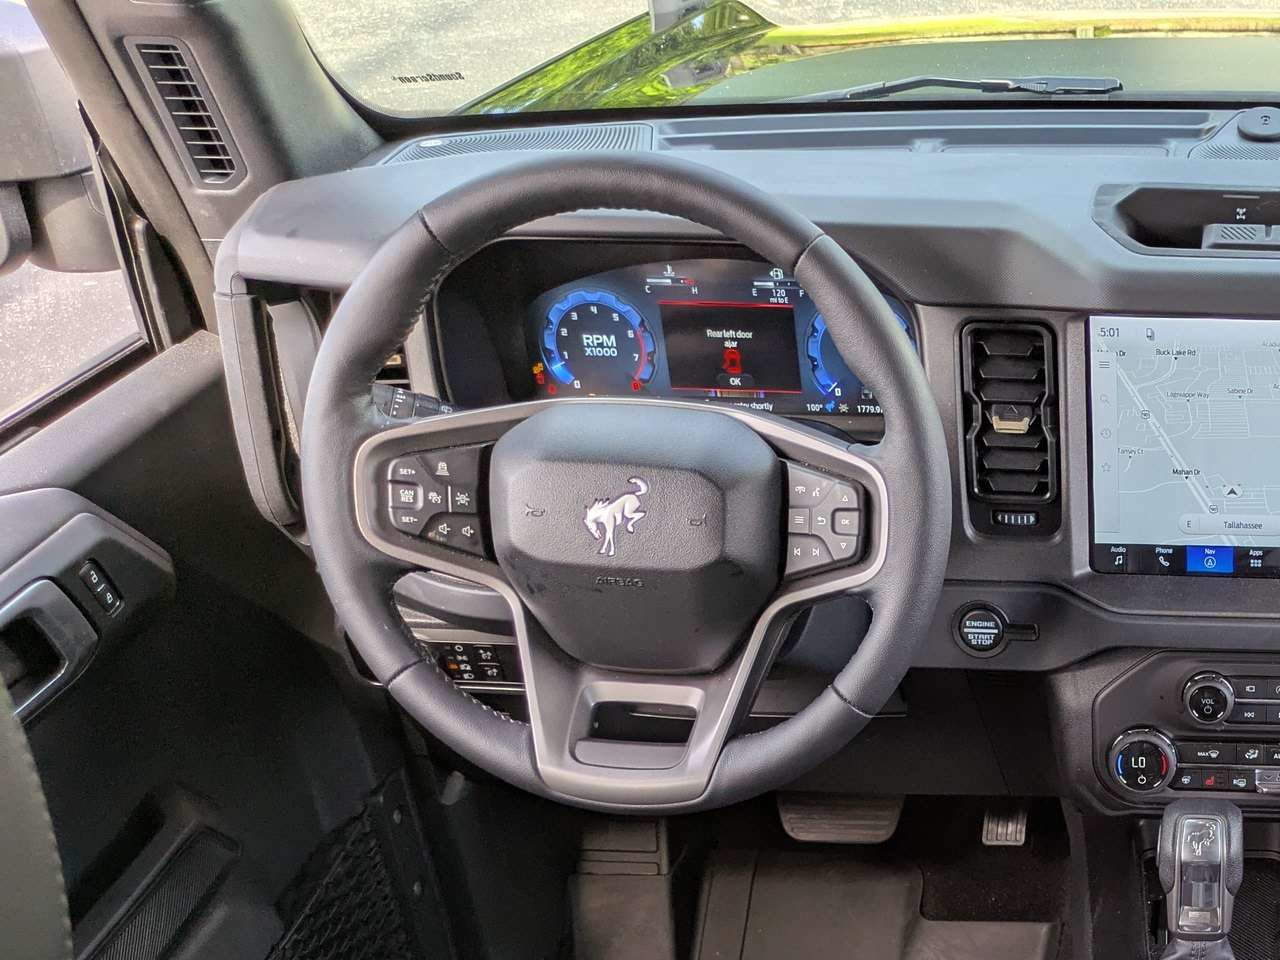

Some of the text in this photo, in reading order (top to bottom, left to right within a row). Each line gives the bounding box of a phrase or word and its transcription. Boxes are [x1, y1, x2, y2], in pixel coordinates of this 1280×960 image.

[645, 286, 651, 294] C
[692, 287, 698, 295] H
[752, 288, 758, 296] E
[772, 289, 786, 297] 120
[590, 305, 598, 314] 4
[571, 312, 578, 321] 3
[612, 313, 619, 321] 5
[560, 328, 568, 336] 2
[627, 330, 634, 338] 6
[706, 329, 753, 339] Rear left door
[1100, 327, 1121, 338] 5:01
[582, 334, 617, 347] RPM
[724, 340, 738, 349] ajar
[563, 351, 569, 360] 1
[584, 347, 618, 357] X1000
[1155, 348, 1196, 357] Buck Lake Rd
[633, 353, 639, 361] 7
[574, 380, 581, 389] 0
[729, 377, 741, 386] OK
[834, 388, 841, 396] 0
[751, 401, 773, 412] shortly
[1172, 468, 1201, 476] Mahan Dr
[1186, 521, 1192, 529] E
[1223, 520, 1263, 530] Tallahassee
[1110, 545, 1127, 553] Audio
[1155, 546, 1173, 554] Phone
[1249, 549, 1263, 557] Apps
[965, 620, 996, 628] ENGINE
[1131, 757, 1146, 769] LO
